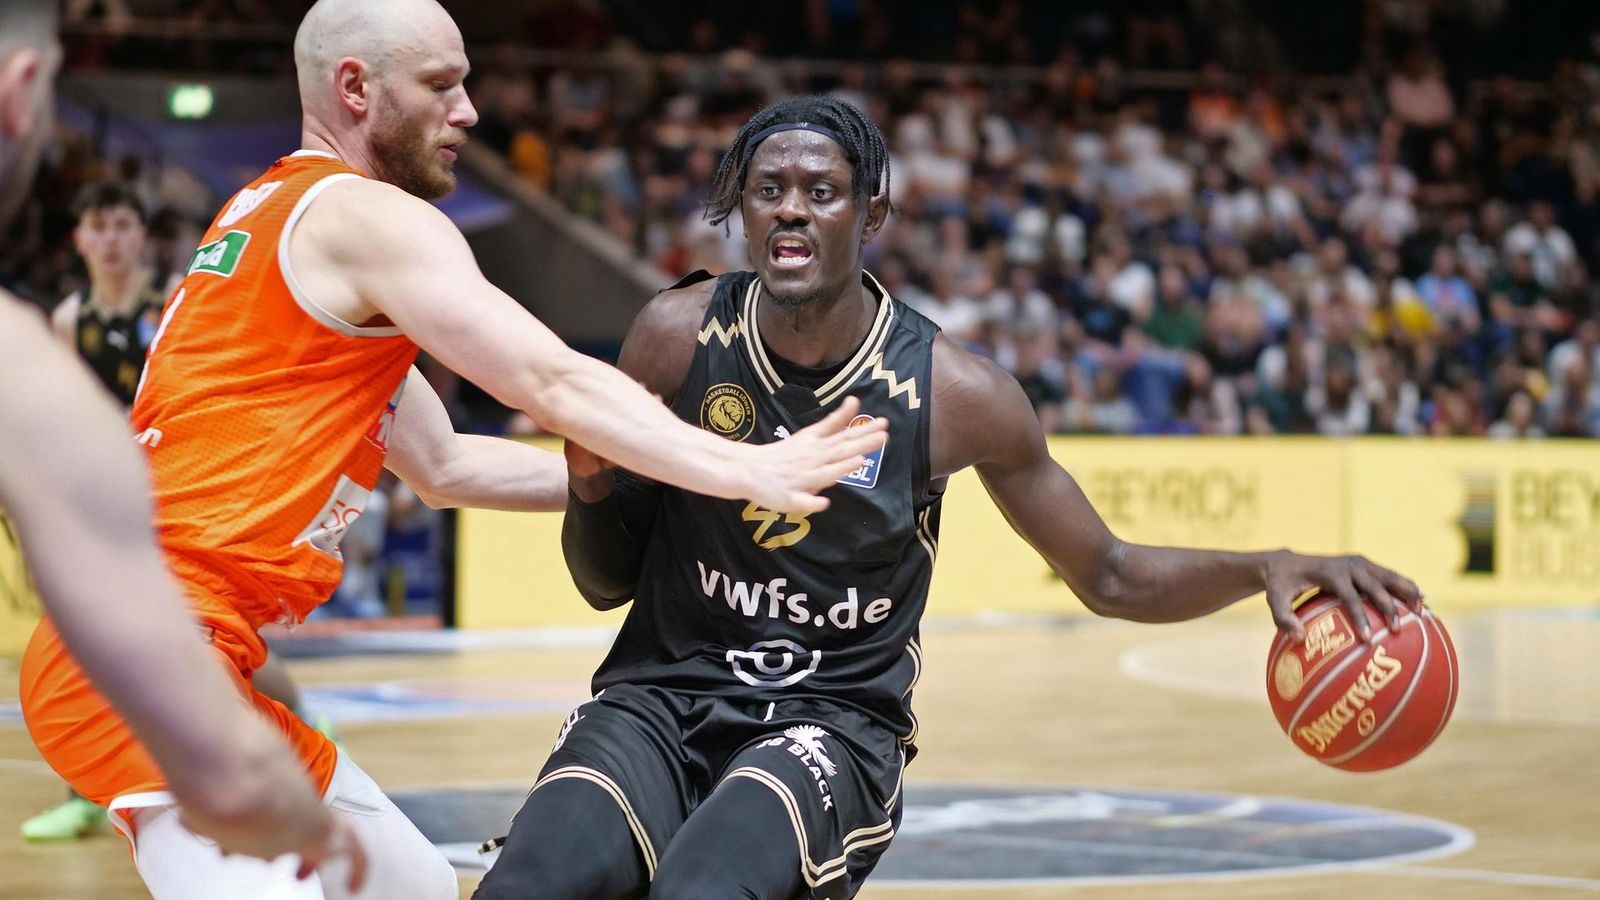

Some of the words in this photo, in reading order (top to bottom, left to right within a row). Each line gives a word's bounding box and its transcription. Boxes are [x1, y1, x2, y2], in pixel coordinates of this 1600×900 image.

[705, 387, 740, 405] BASKETBALL
[697, 560, 893, 630] vwfs.de
[1295, 644, 1402, 754] SPALDING
[786, 743, 834, 812] BLACK
